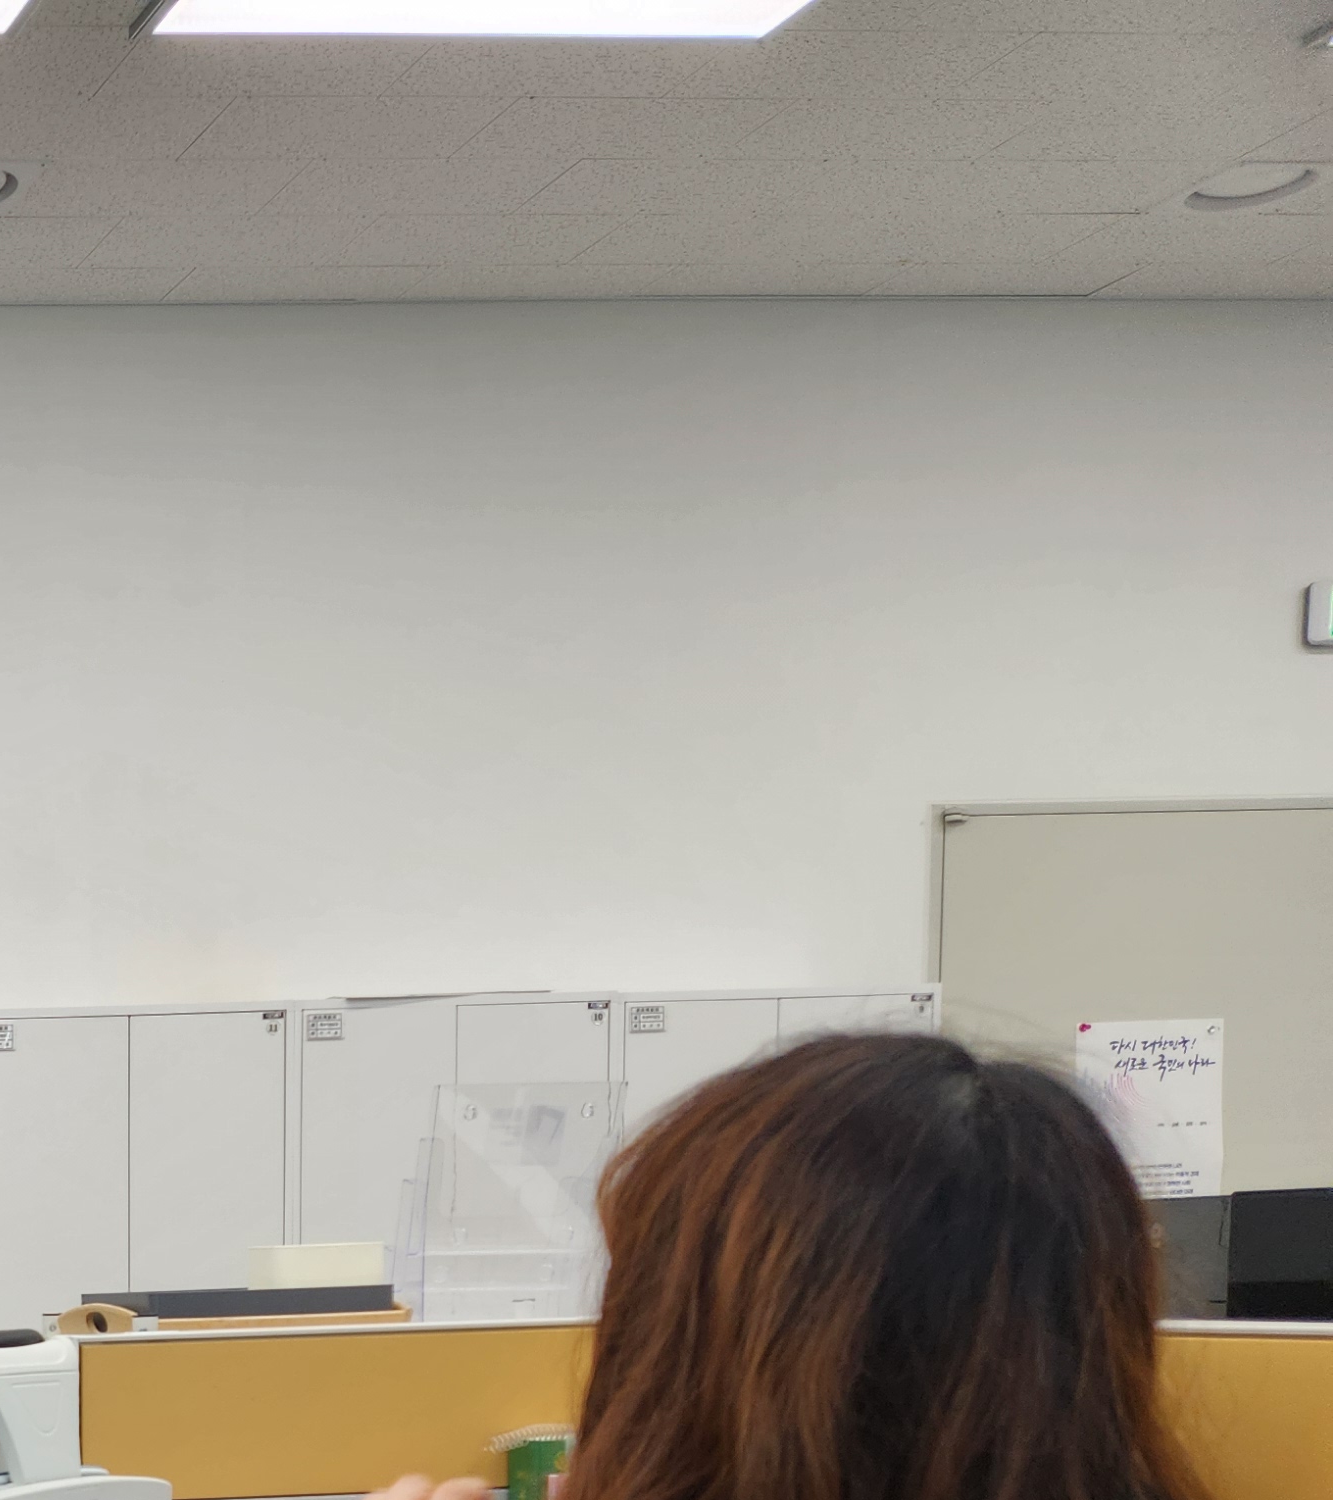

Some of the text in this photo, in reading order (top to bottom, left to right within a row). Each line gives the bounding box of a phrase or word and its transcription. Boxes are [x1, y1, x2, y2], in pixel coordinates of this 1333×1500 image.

[594, 1013, 603, 1021] 10
[1109, 1035, 1197, 1055] 다시 대한민국!
[1114, 1053, 1216, 1082] 새로운 국민의 나라
